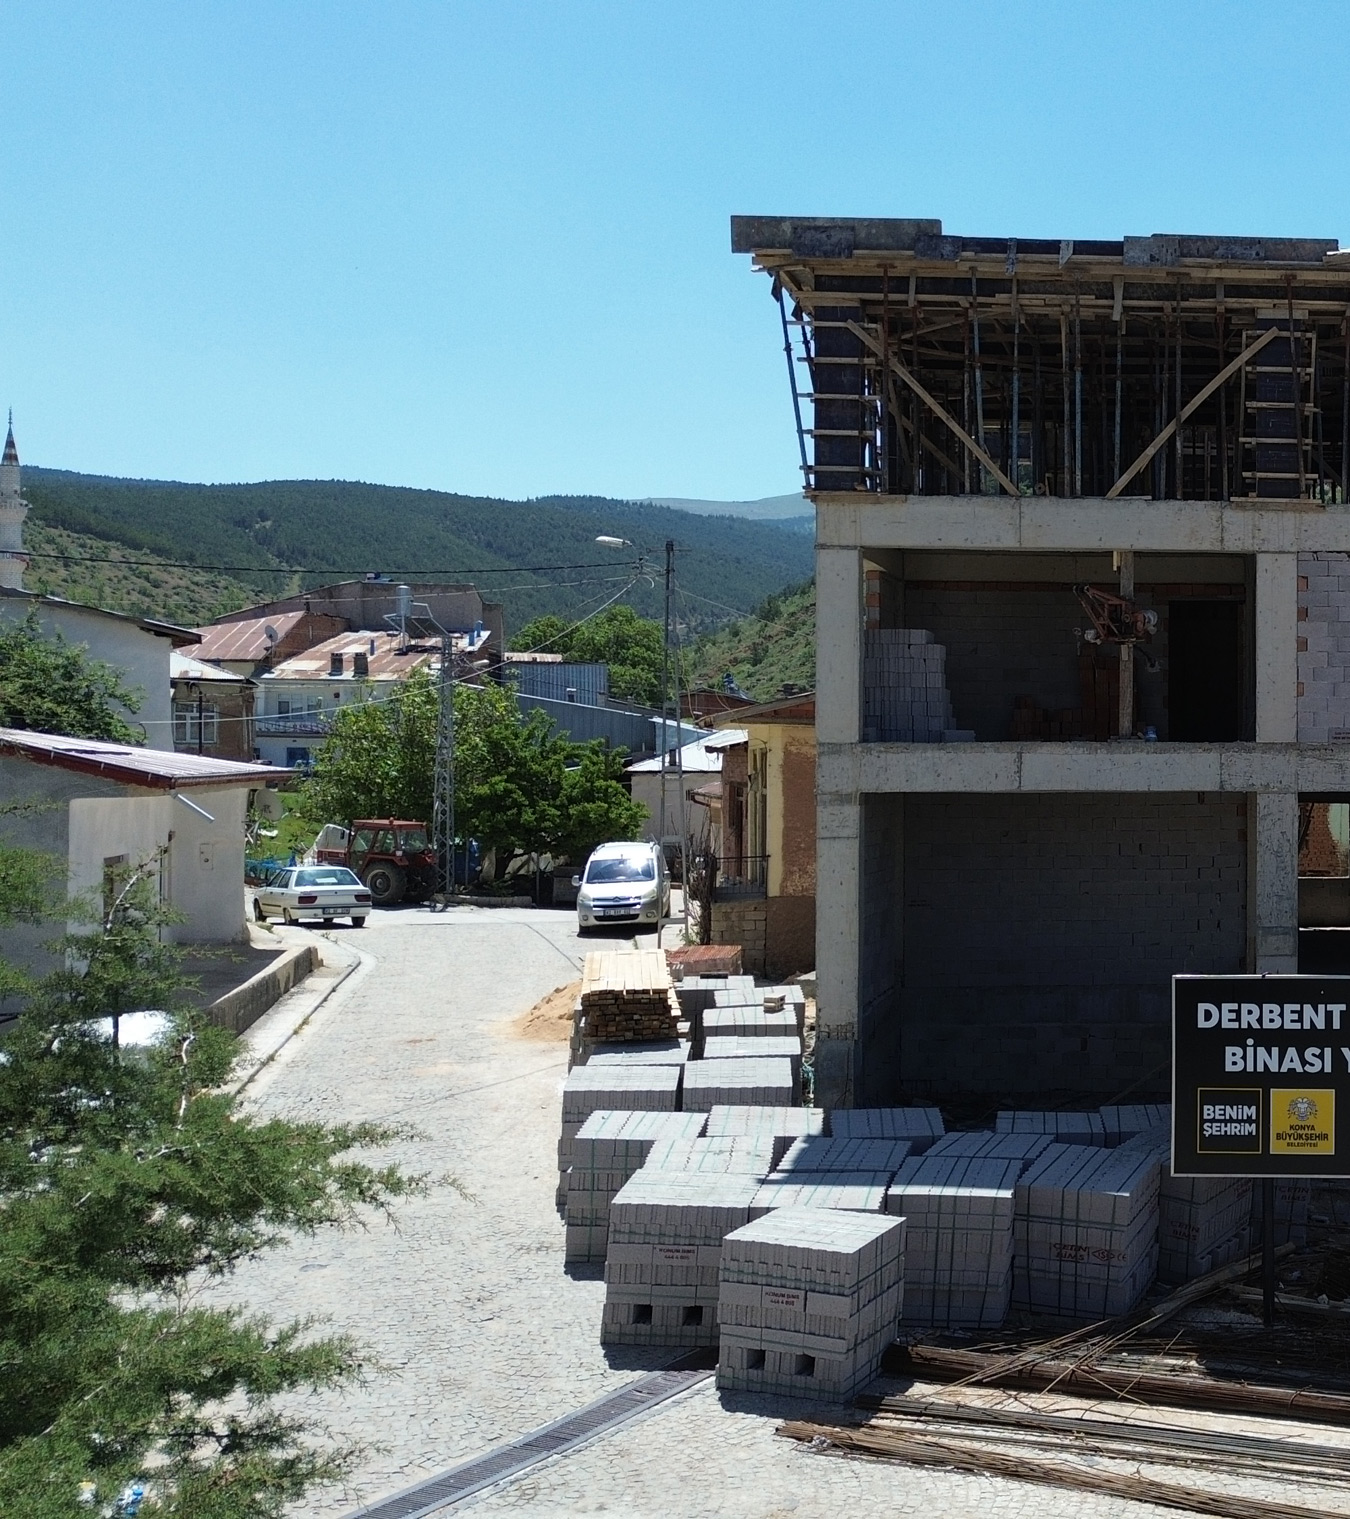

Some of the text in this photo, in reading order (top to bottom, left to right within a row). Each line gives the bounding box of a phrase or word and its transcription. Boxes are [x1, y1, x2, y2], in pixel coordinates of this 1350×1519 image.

[1197, 1002, 1347, 1030] DERBENT
[1224, 1038, 1332, 1073] BİNASI
[1203, 1104, 1257, 1120] BENİM
[1203, 1122, 1257, 1137] ŞEHRİM
[1276, 1131, 1329, 1142] BÜYÜKŞEHİR
